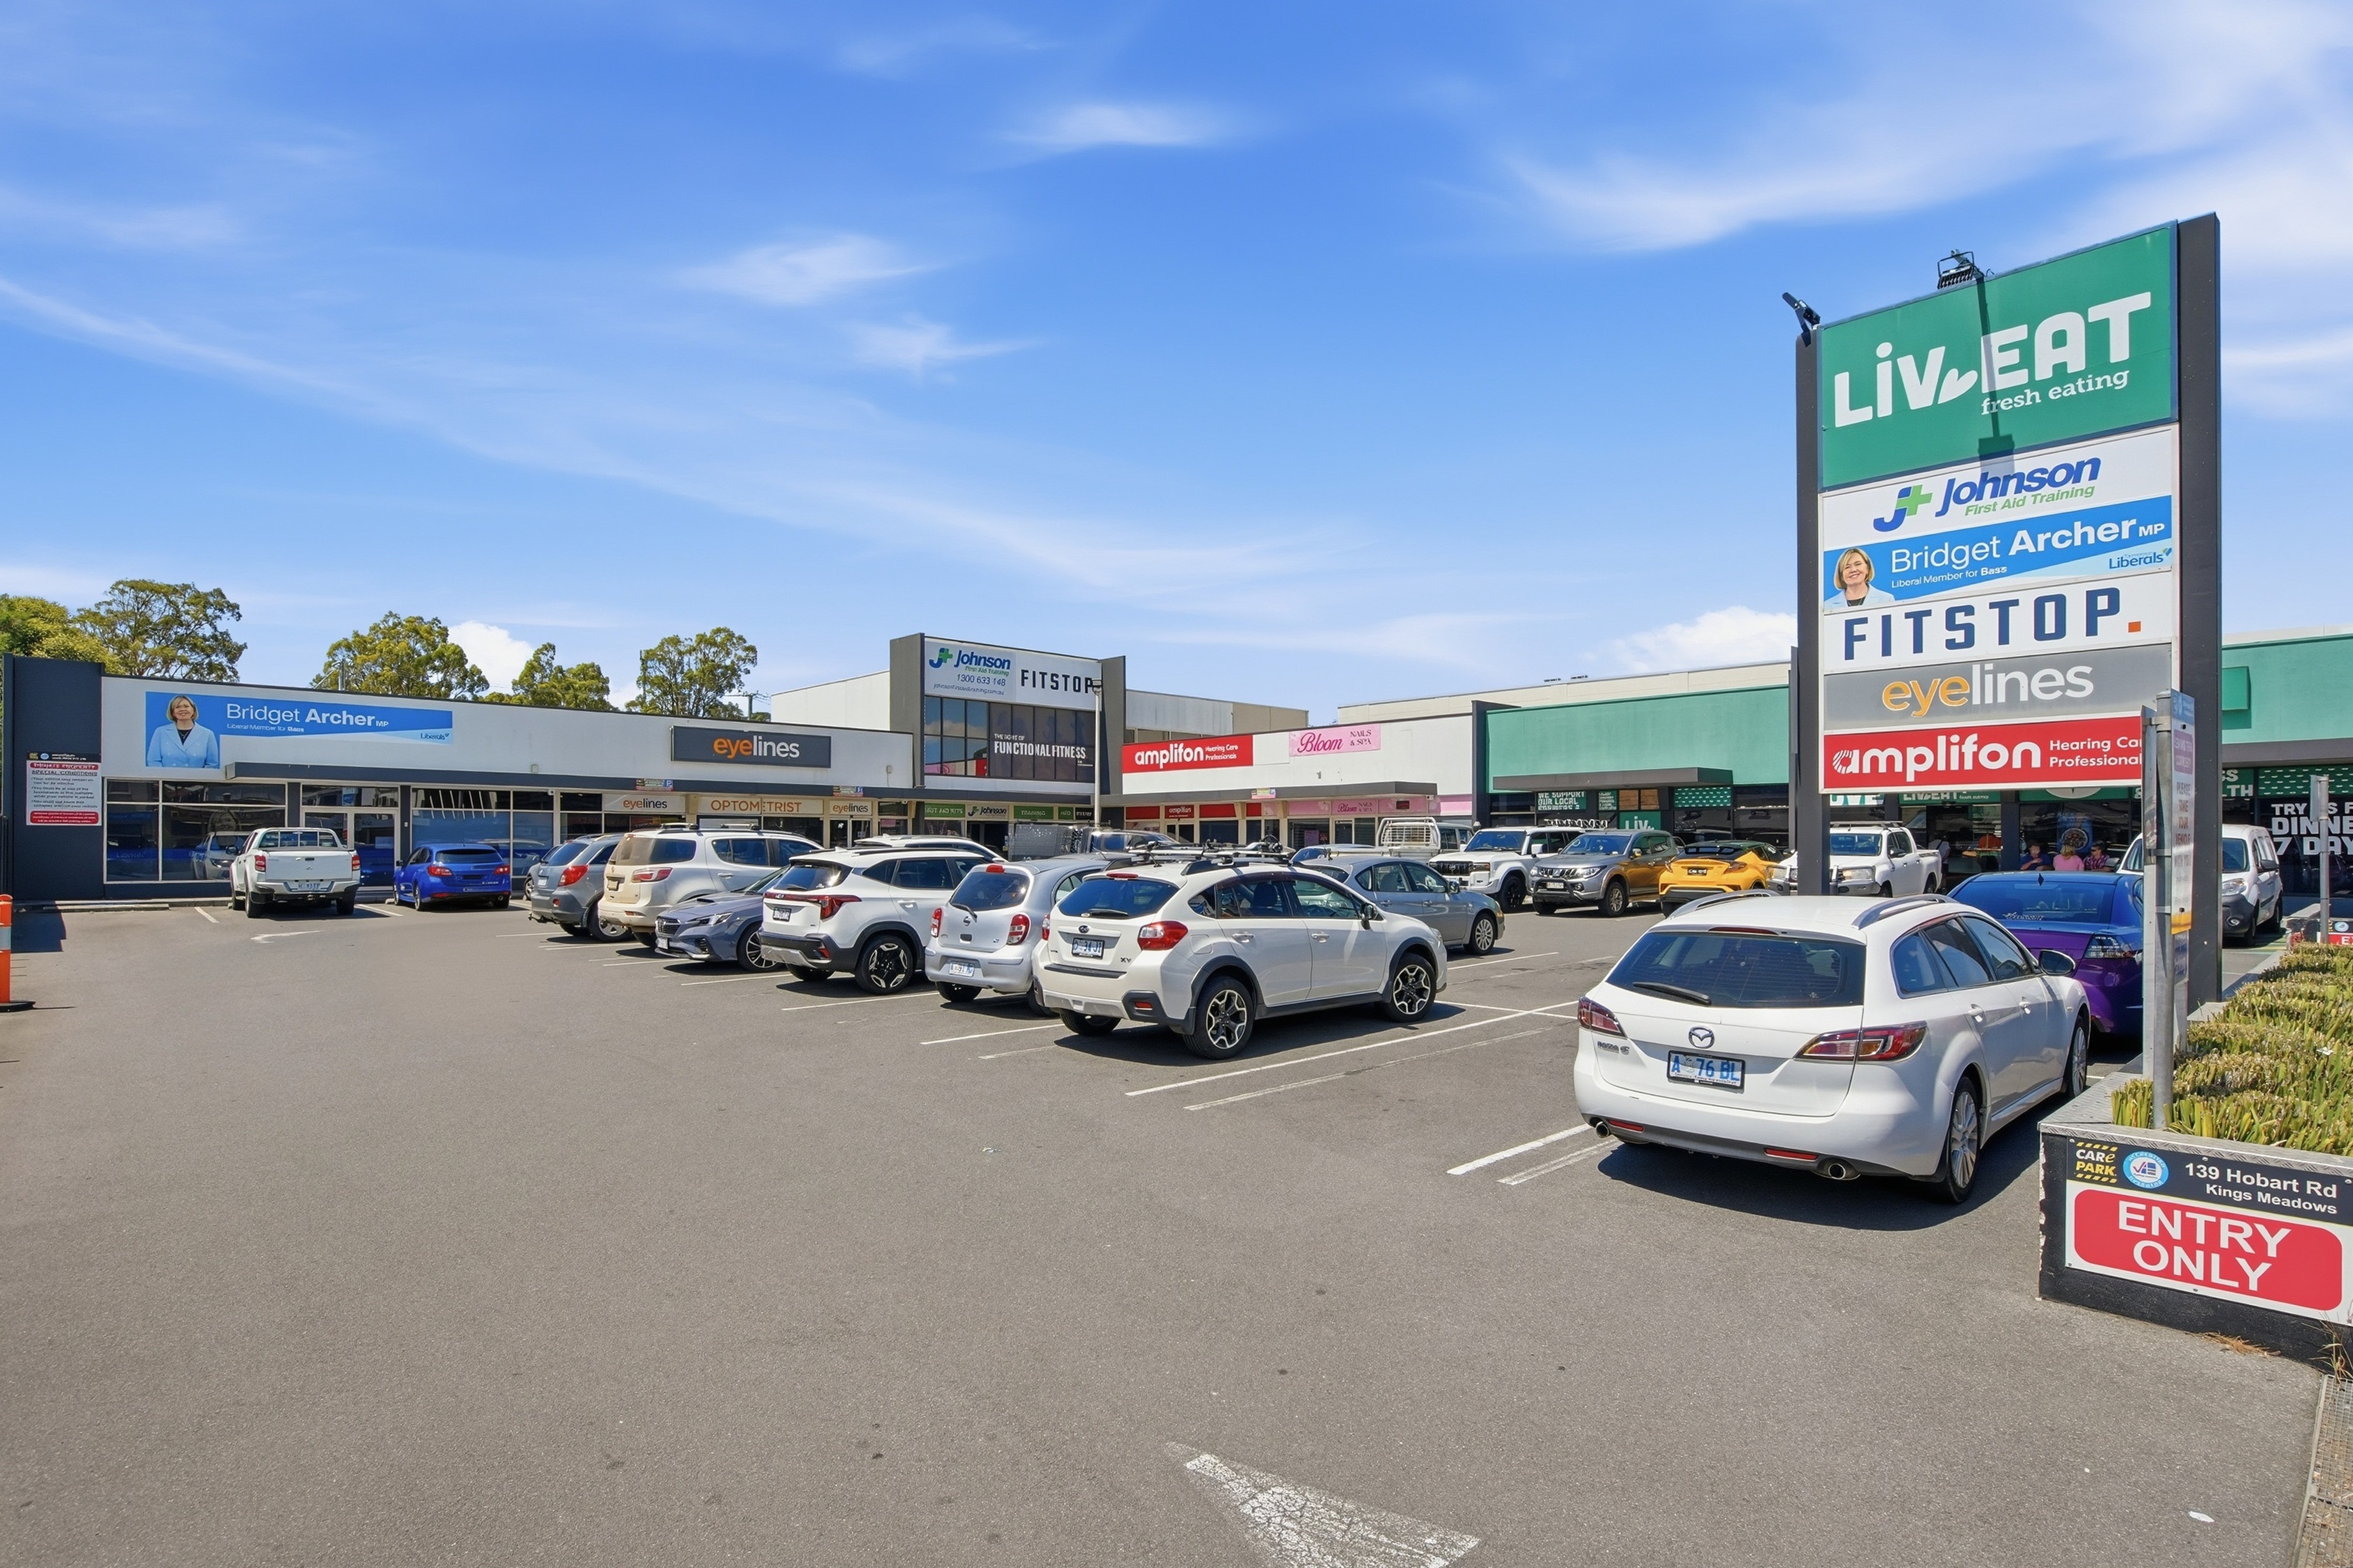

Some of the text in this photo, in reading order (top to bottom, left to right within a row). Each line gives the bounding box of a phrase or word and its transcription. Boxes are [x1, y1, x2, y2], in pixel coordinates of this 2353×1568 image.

[1981, 370, 2130, 415] fresh eating
[1935, 457, 2101, 518] Johnson
[1965, 486, 2095, 516] First Aid Training
[1892, 518, 2165, 573] Bridget Archer MP
[2109, 552, 2164, 569] Liberals
[1892, 576, 1922, 588] Liberal
[1923, 572, 1964, 584] Member
[1981, 566, 2008, 576] Bass
[954, 650, 1011, 670] Johnson
[957, 674, 1006, 686] 1300 633 148
[1021, 669, 1094, 694] FITSTOP
[1881, 663, 2095, 718] eyelines
[227, 703, 300, 725] Bridget
[305, 708, 375, 726] Archer
[420, 732, 445, 741] Liberals
[713, 735, 800, 760] eyelines
[1297, 729, 1372, 753] Bloom NAILS
[2049, 737, 2142, 752] Hearing Ca
[994, 741, 1051, 757] FUNCTIONAL
[1135, 743, 1204, 769] amplifon
[1832, 733, 2041, 782] amplifon
[623, 798, 668, 810] eyelines
[832, 802, 868, 814] eyelines
[2271, 803, 2308, 816] TRY
[2273, 837, 2293, 856] 7
[1671, 1055, 1680, 1073] A
[1696, 1058, 1714, 1077] 76
[1720, 1060, 1739, 1082] BL
[2076, 1161, 2116, 1176] PARK
[2185, 1162, 2337, 1198] 139 Hobart Rd
[2206, 1183, 2338, 1215] Kings Meadows
[2119, 1200, 2292, 1258] ENTRY
[2133, 1240, 2272, 1292] ONLY
